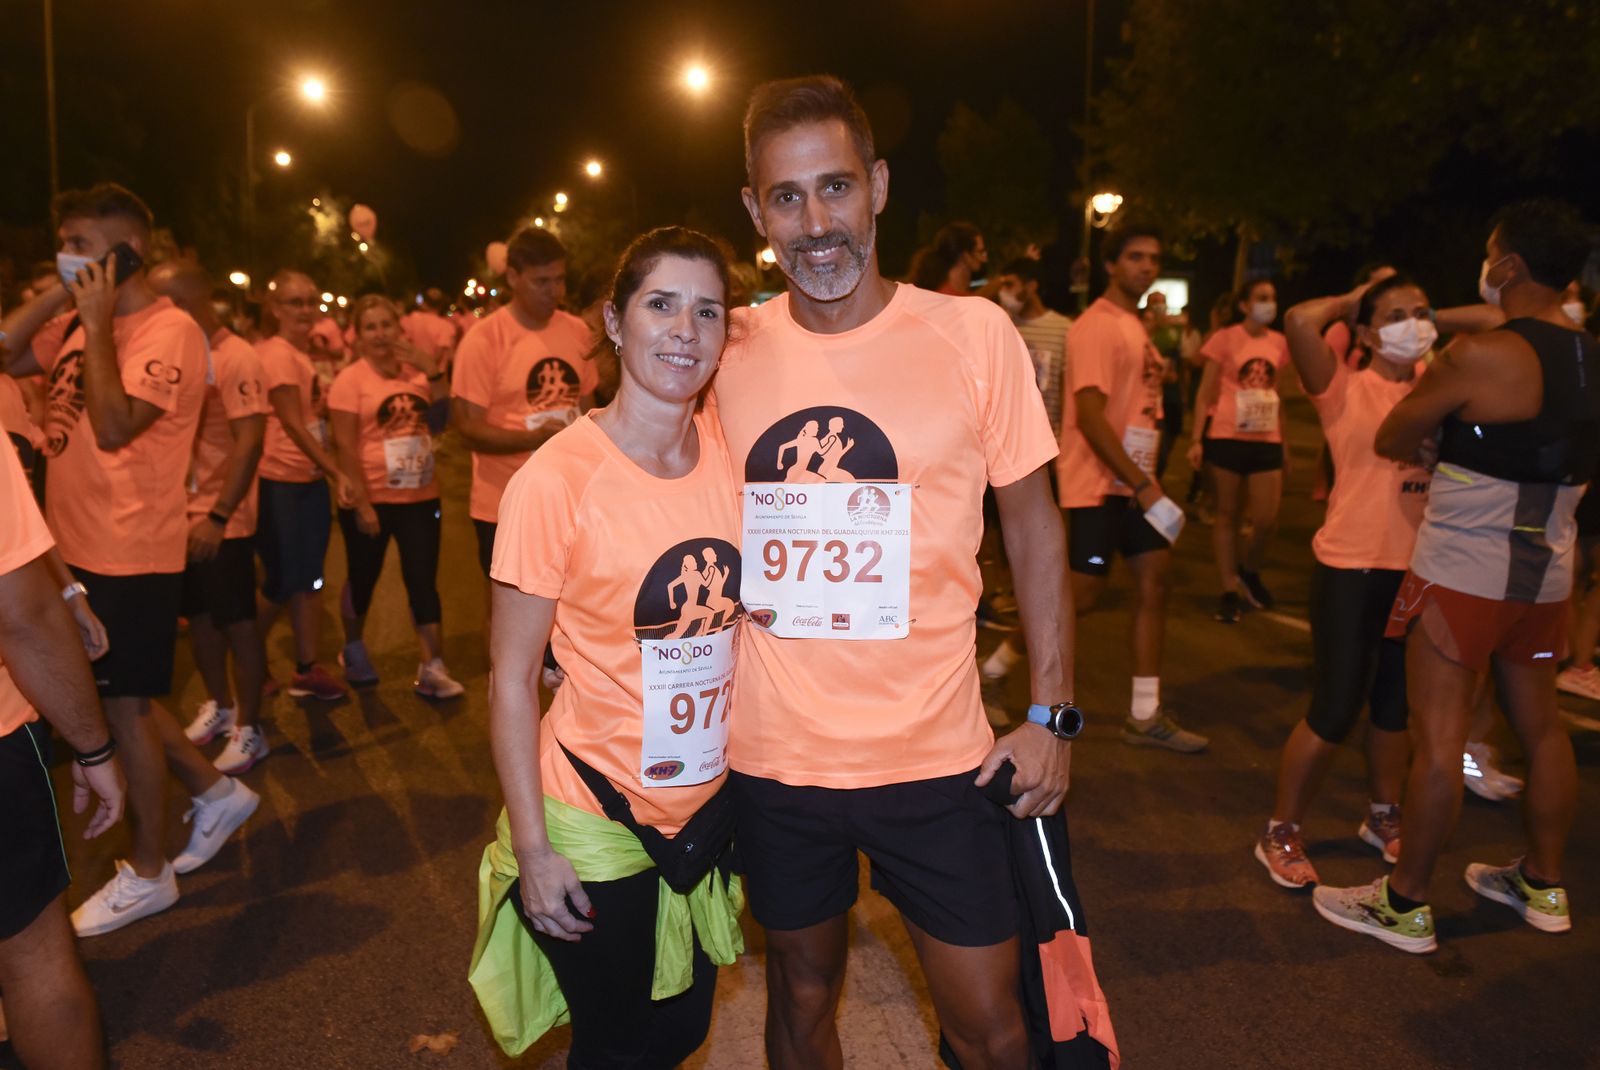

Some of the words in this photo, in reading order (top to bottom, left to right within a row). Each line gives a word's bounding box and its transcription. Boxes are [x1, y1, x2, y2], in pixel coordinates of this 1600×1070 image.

[833, 528, 880, 536] GUADALQUIVIR
[763, 539, 883, 583] 9732
[668, 682, 694, 690] CARRERA
[694, 675, 721, 687] NOCTURNA
